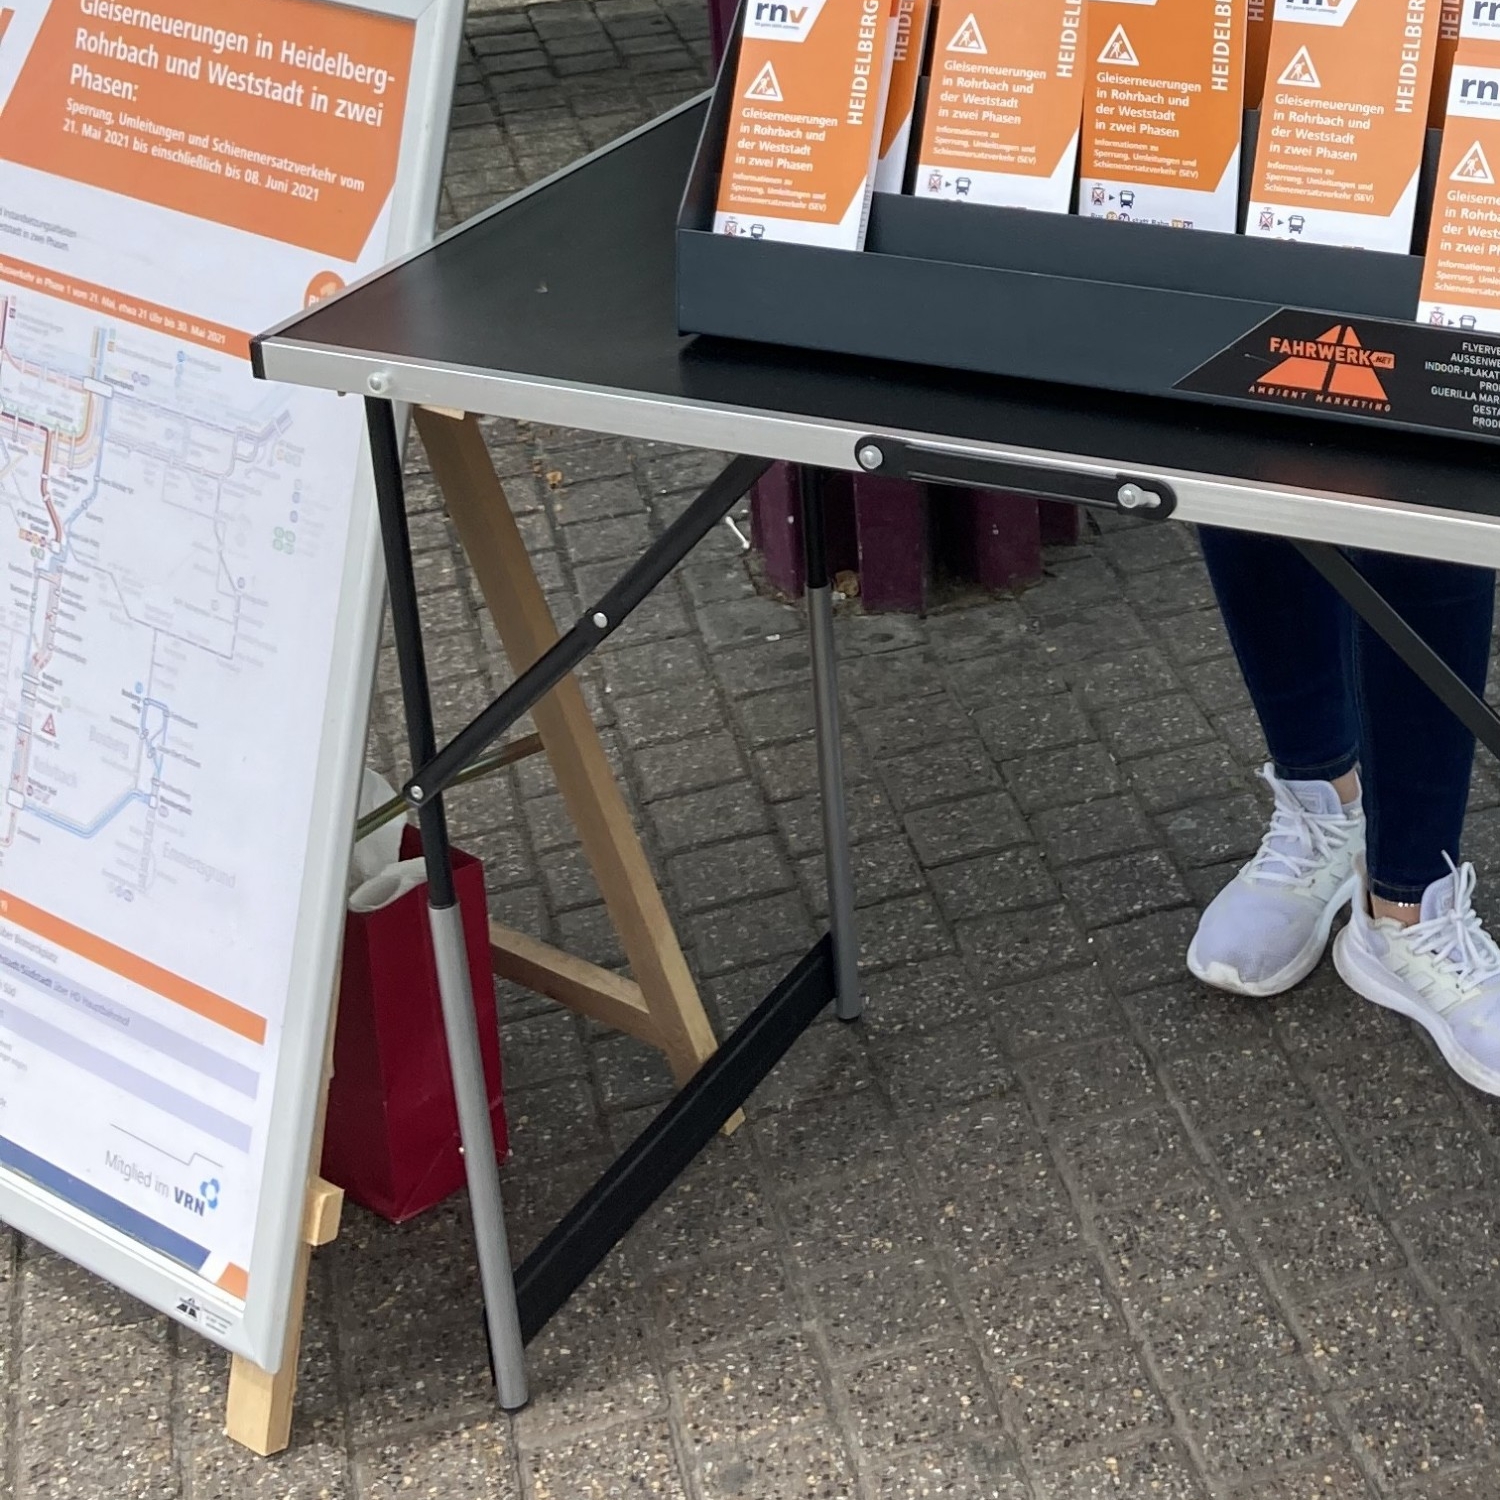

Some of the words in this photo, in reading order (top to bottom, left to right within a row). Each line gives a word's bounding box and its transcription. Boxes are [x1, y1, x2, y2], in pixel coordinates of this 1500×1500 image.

[755, 1, 809, 24] rnv
[75, 27, 159, 70] Rohrbach
[165, 54, 202, 80] und
[208, 60, 305, 107] Weststadt
[310, 86, 329, 114] in
[334, 102, 384, 128] zwei
[255, 33, 273, 60] in
[280, 40, 396, 94] Heidelberg-
[70, 63, 139, 102] Phasen:
[1096, 71, 1202, 93] Gleiserneuerungen
[1096, 88, 1107, 98] in
[1111, 89, 1165, 105] Rohrbach
[1168, 95, 1190, 107] und
[1095, 103, 1115, 115] der
[1118, 105, 1176, 122] Weststadt
[1095, 119, 1106, 131] in
[1109, 121, 1136, 134] zwei
[1139, 123, 1180, 138] Phasen
[66, 97, 115, 125] Sperrung,
[118, 111, 186, 143] Umleitungen
[188, 134, 211, 149] und
[212, 137, 338, 184] Schienenersatzverkehr
[340, 174, 365, 192] vom
[62, 118, 78, 135] 21.
[81, 122, 102, 140] Mai
[104, 129, 129, 148] 2021
[132, 136, 148, 154] bis
[151, 144, 222, 175] einschließlich
[225, 162, 241, 180] bis
[244, 169, 262, 187] 08.
[265, 174, 289, 193] Juni
[291, 181, 320, 202] 2021
[1269, 336, 1372, 366] FAHRWERK
[1248, 384, 1307, 400] AMBIENT
[1315, 393, 1392, 413] MARKETING
[1430, 385, 1477, 402] GUERILLA
[105, 1149, 153, 1189] Mitglied
[154, 1177, 170, 1198] im
[174, 1186, 206, 1216] VRN
